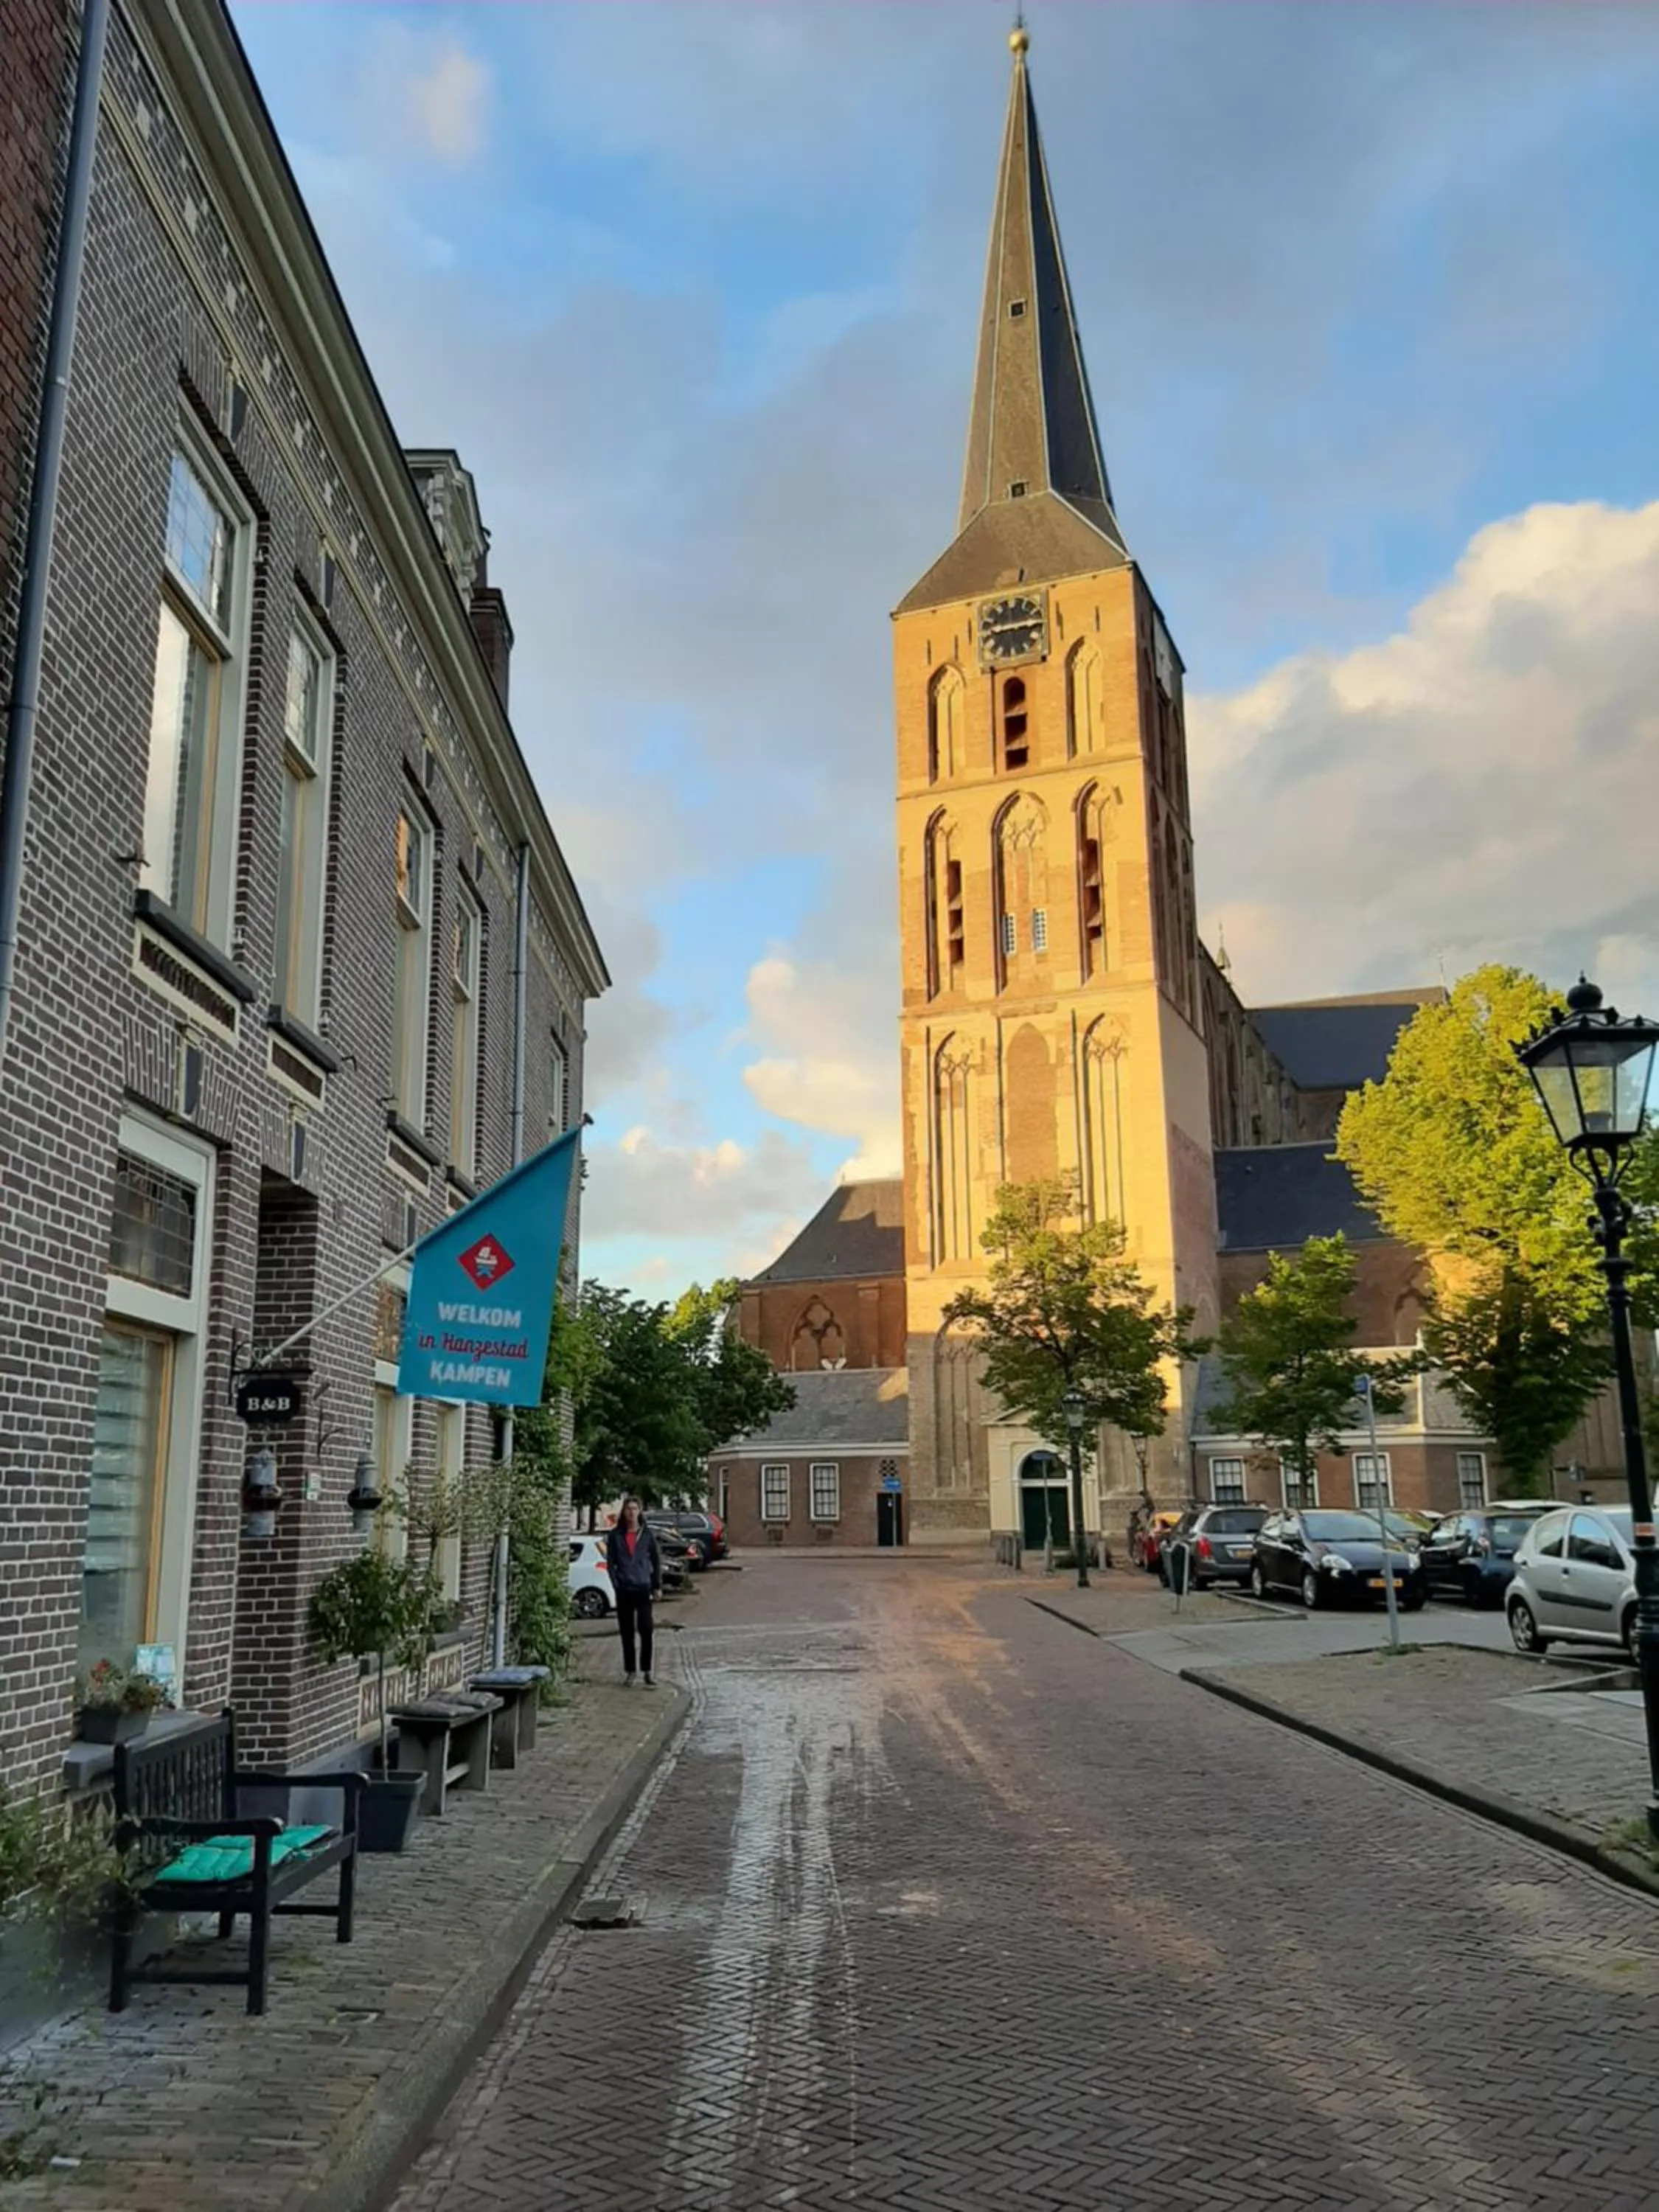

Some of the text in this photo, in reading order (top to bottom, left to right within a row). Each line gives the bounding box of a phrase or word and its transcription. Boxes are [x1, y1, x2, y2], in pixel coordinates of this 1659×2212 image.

[437, 1301, 522, 1328] WELKOM
[418, 1329, 529, 1363] in Hanzestad
[430, 1360, 512, 1388] KAMPEN
[247, 1397, 291, 1411] B&B
